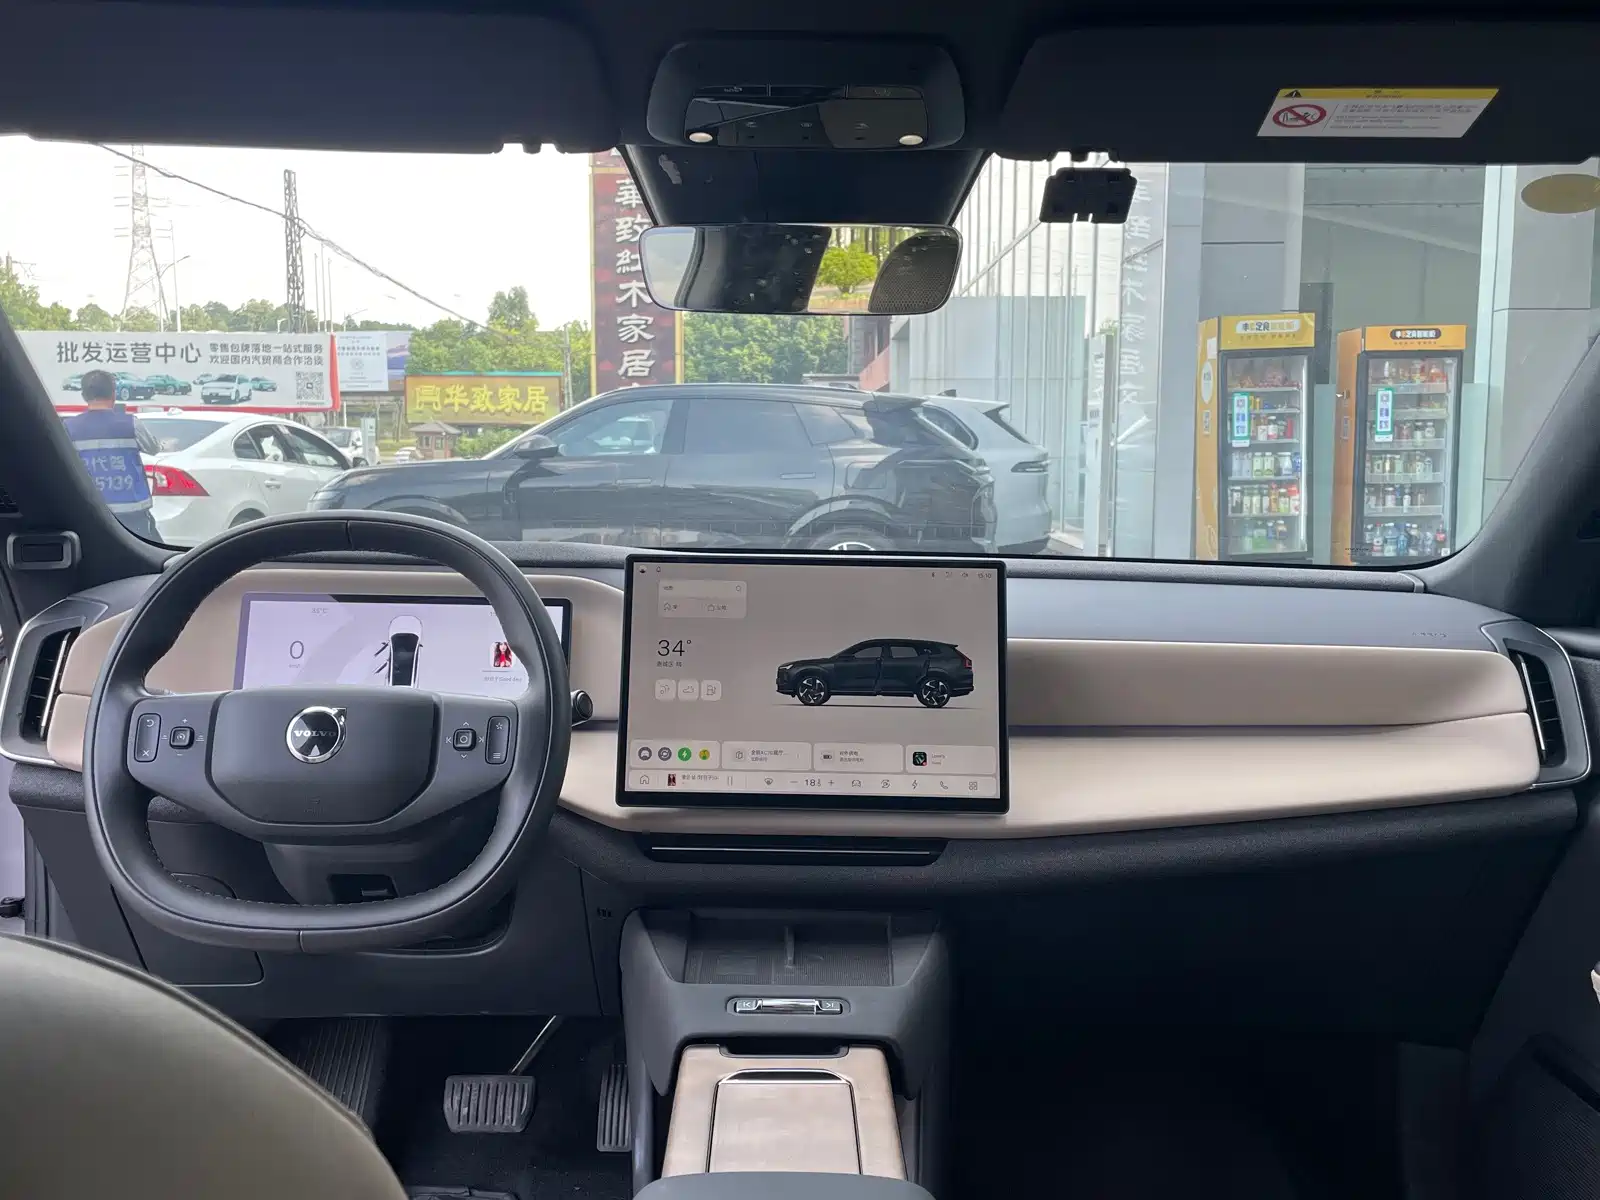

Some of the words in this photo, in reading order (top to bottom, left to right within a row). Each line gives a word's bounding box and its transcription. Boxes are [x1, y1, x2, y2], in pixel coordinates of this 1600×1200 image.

[614, 178, 656, 387] 華致紅木家居
[56, 341, 203, 364] 批发运营中心
[209, 342, 323, 354] 零售包牌落地一站式服务
[209, 355, 324, 366] 欢迎国内汽贸商合作洽谈
[289, 640, 304, 659] 0
[657, 639, 692, 657] 34°
